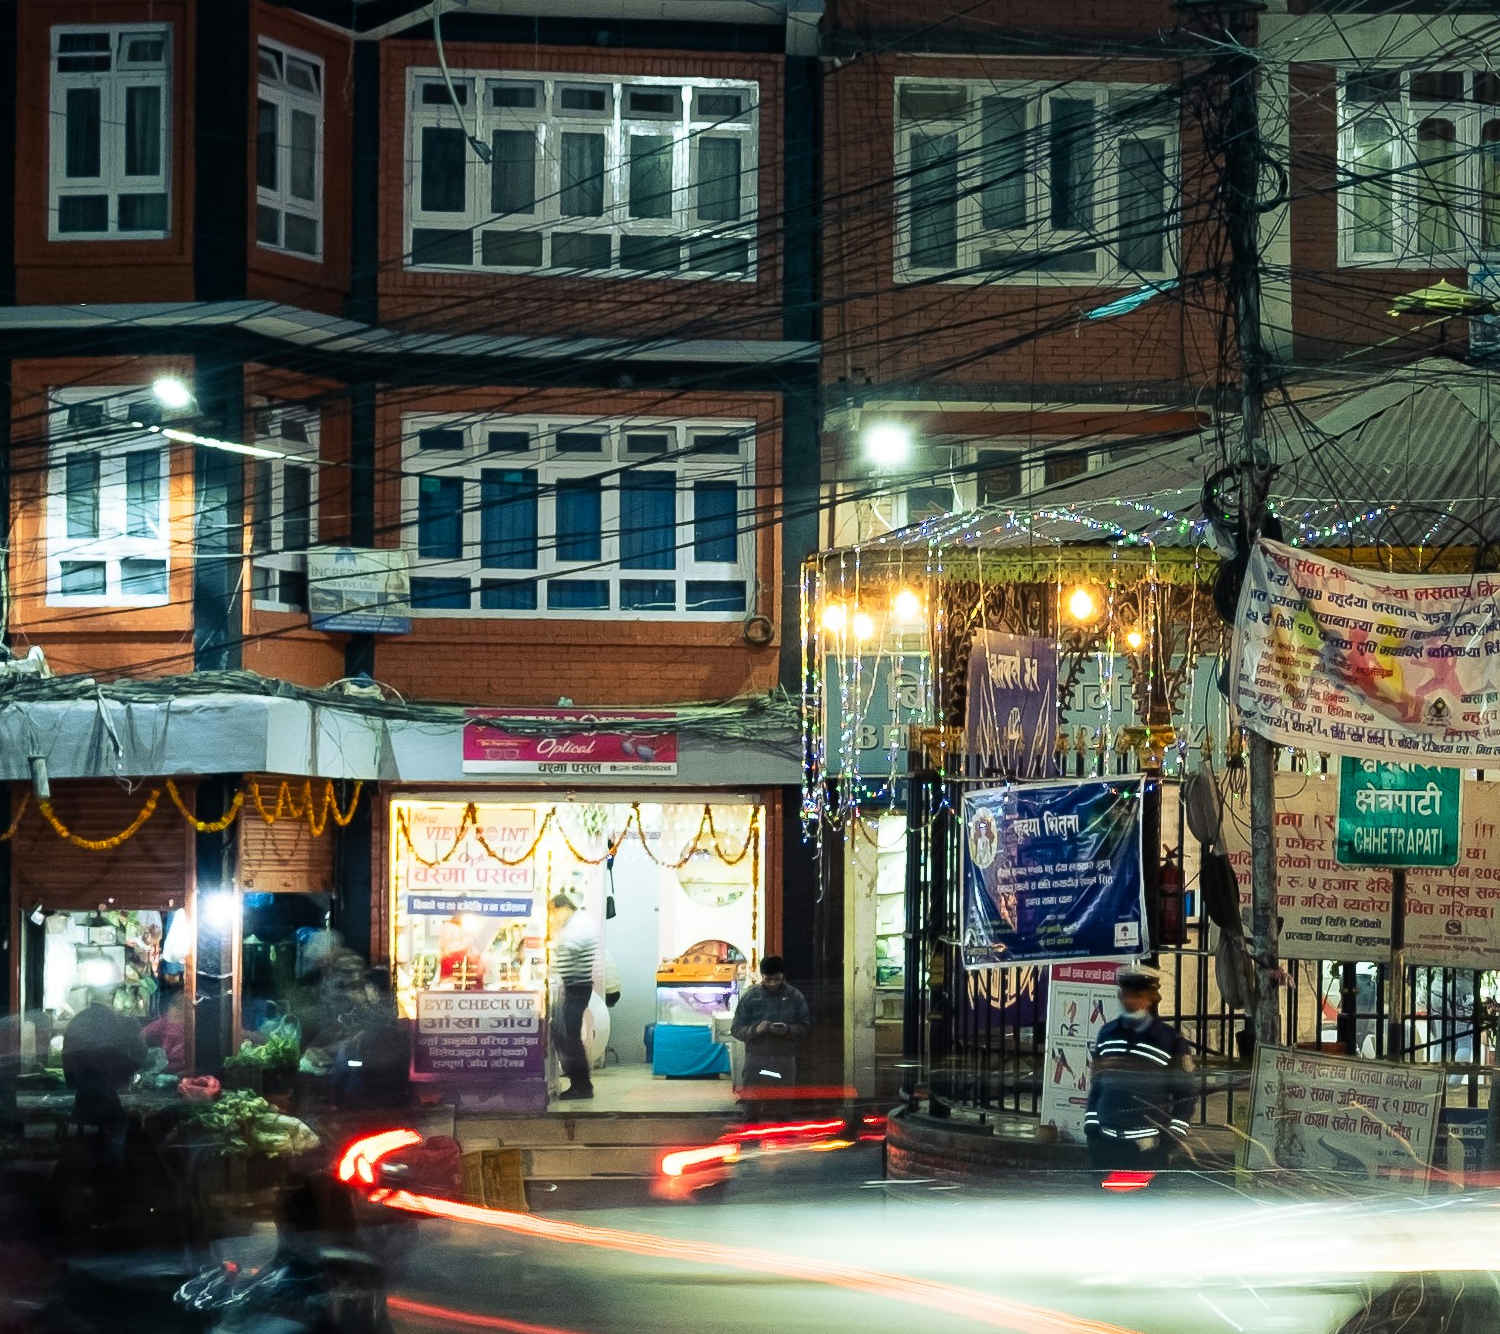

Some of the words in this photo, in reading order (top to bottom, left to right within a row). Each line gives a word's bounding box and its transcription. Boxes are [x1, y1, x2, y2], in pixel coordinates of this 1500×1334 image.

[536, 738, 596, 759] Optical
[1354, 782, 1443, 816] क्षेत्रपाटी
[1354, 827, 1443, 856] CHHETRAPATI
[476, 867, 529, 884] पसल
[424, 999, 454, 1011] EYE
[458, 998, 511, 1011] CHECK
[516, 998, 535, 1011] UP
